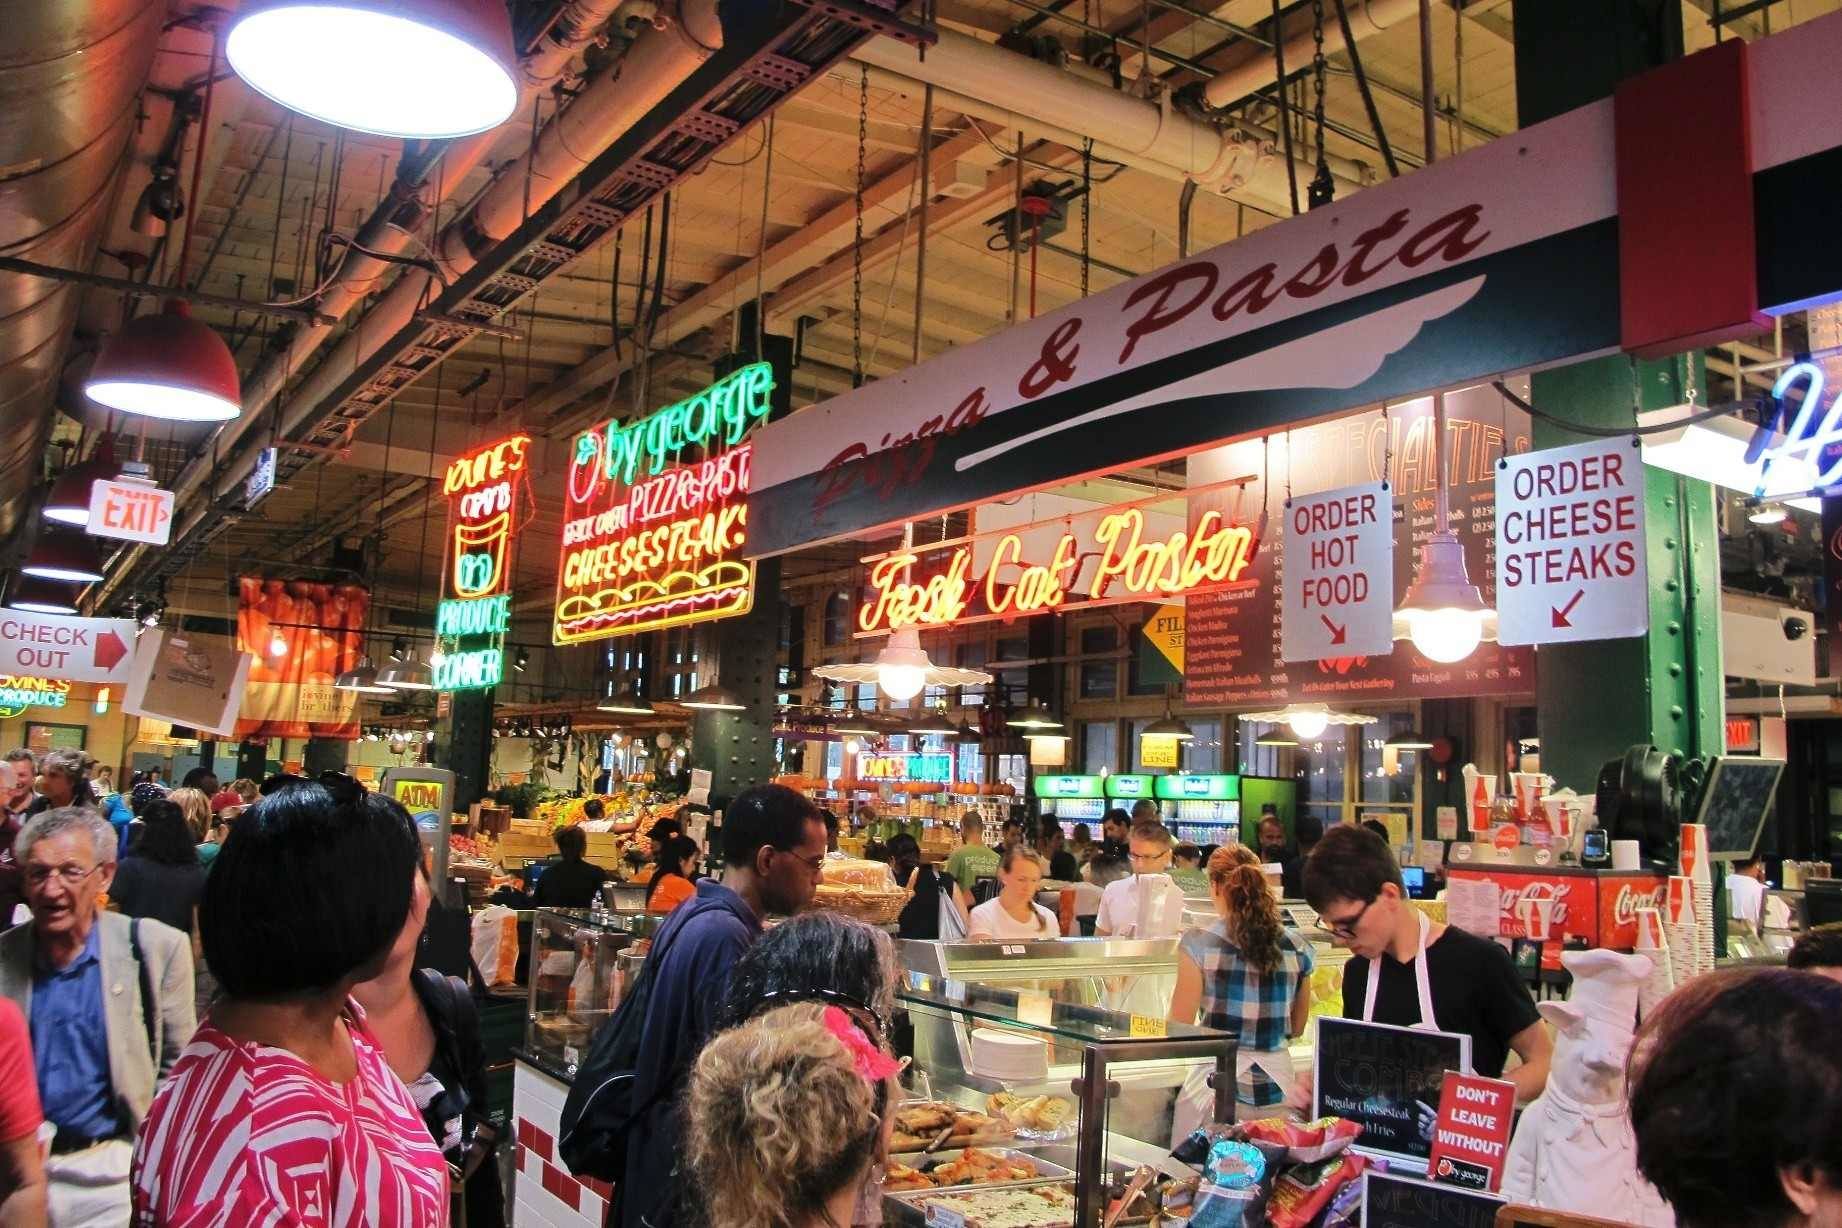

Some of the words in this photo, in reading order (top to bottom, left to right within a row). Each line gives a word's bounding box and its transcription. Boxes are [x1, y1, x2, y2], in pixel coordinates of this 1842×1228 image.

[811, 386, 992, 512] Pizza
[1018, 316, 1083, 399] &
[1117, 203, 1491, 365] Pasta
[604, 418, 645, 486] by
[646, 362, 774, 475] george
[629, 467, 690, 525] PIZZA
[1514, 453, 1624, 501] ORDER
[102, 487, 166, 534] EXIT
[1294, 494, 1377, 536] ORDER
[1503, 495, 1636, 545] CHEESE
[1311, 535, 1359, 571] HOT
[1504, 541, 1636, 588] STEAKS
[1302, 572, 1368, 609] FOOD
[1, 620, 88, 647] CHECK
[16, 648, 71, 669] OUT
[433, 648, 501, 692] CORNER
[400, 784, 440, 810] ATM
[1325, 1094, 1357, 1112] Regular
[1358, 1100, 1411, 1120] Cheesesteak
[1456, 1084, 1499, 1106] DON'T
[1450, 1108, 1497, 1130] LEAVE
[1437, 1128, 1503, 1157] WITHOUT
